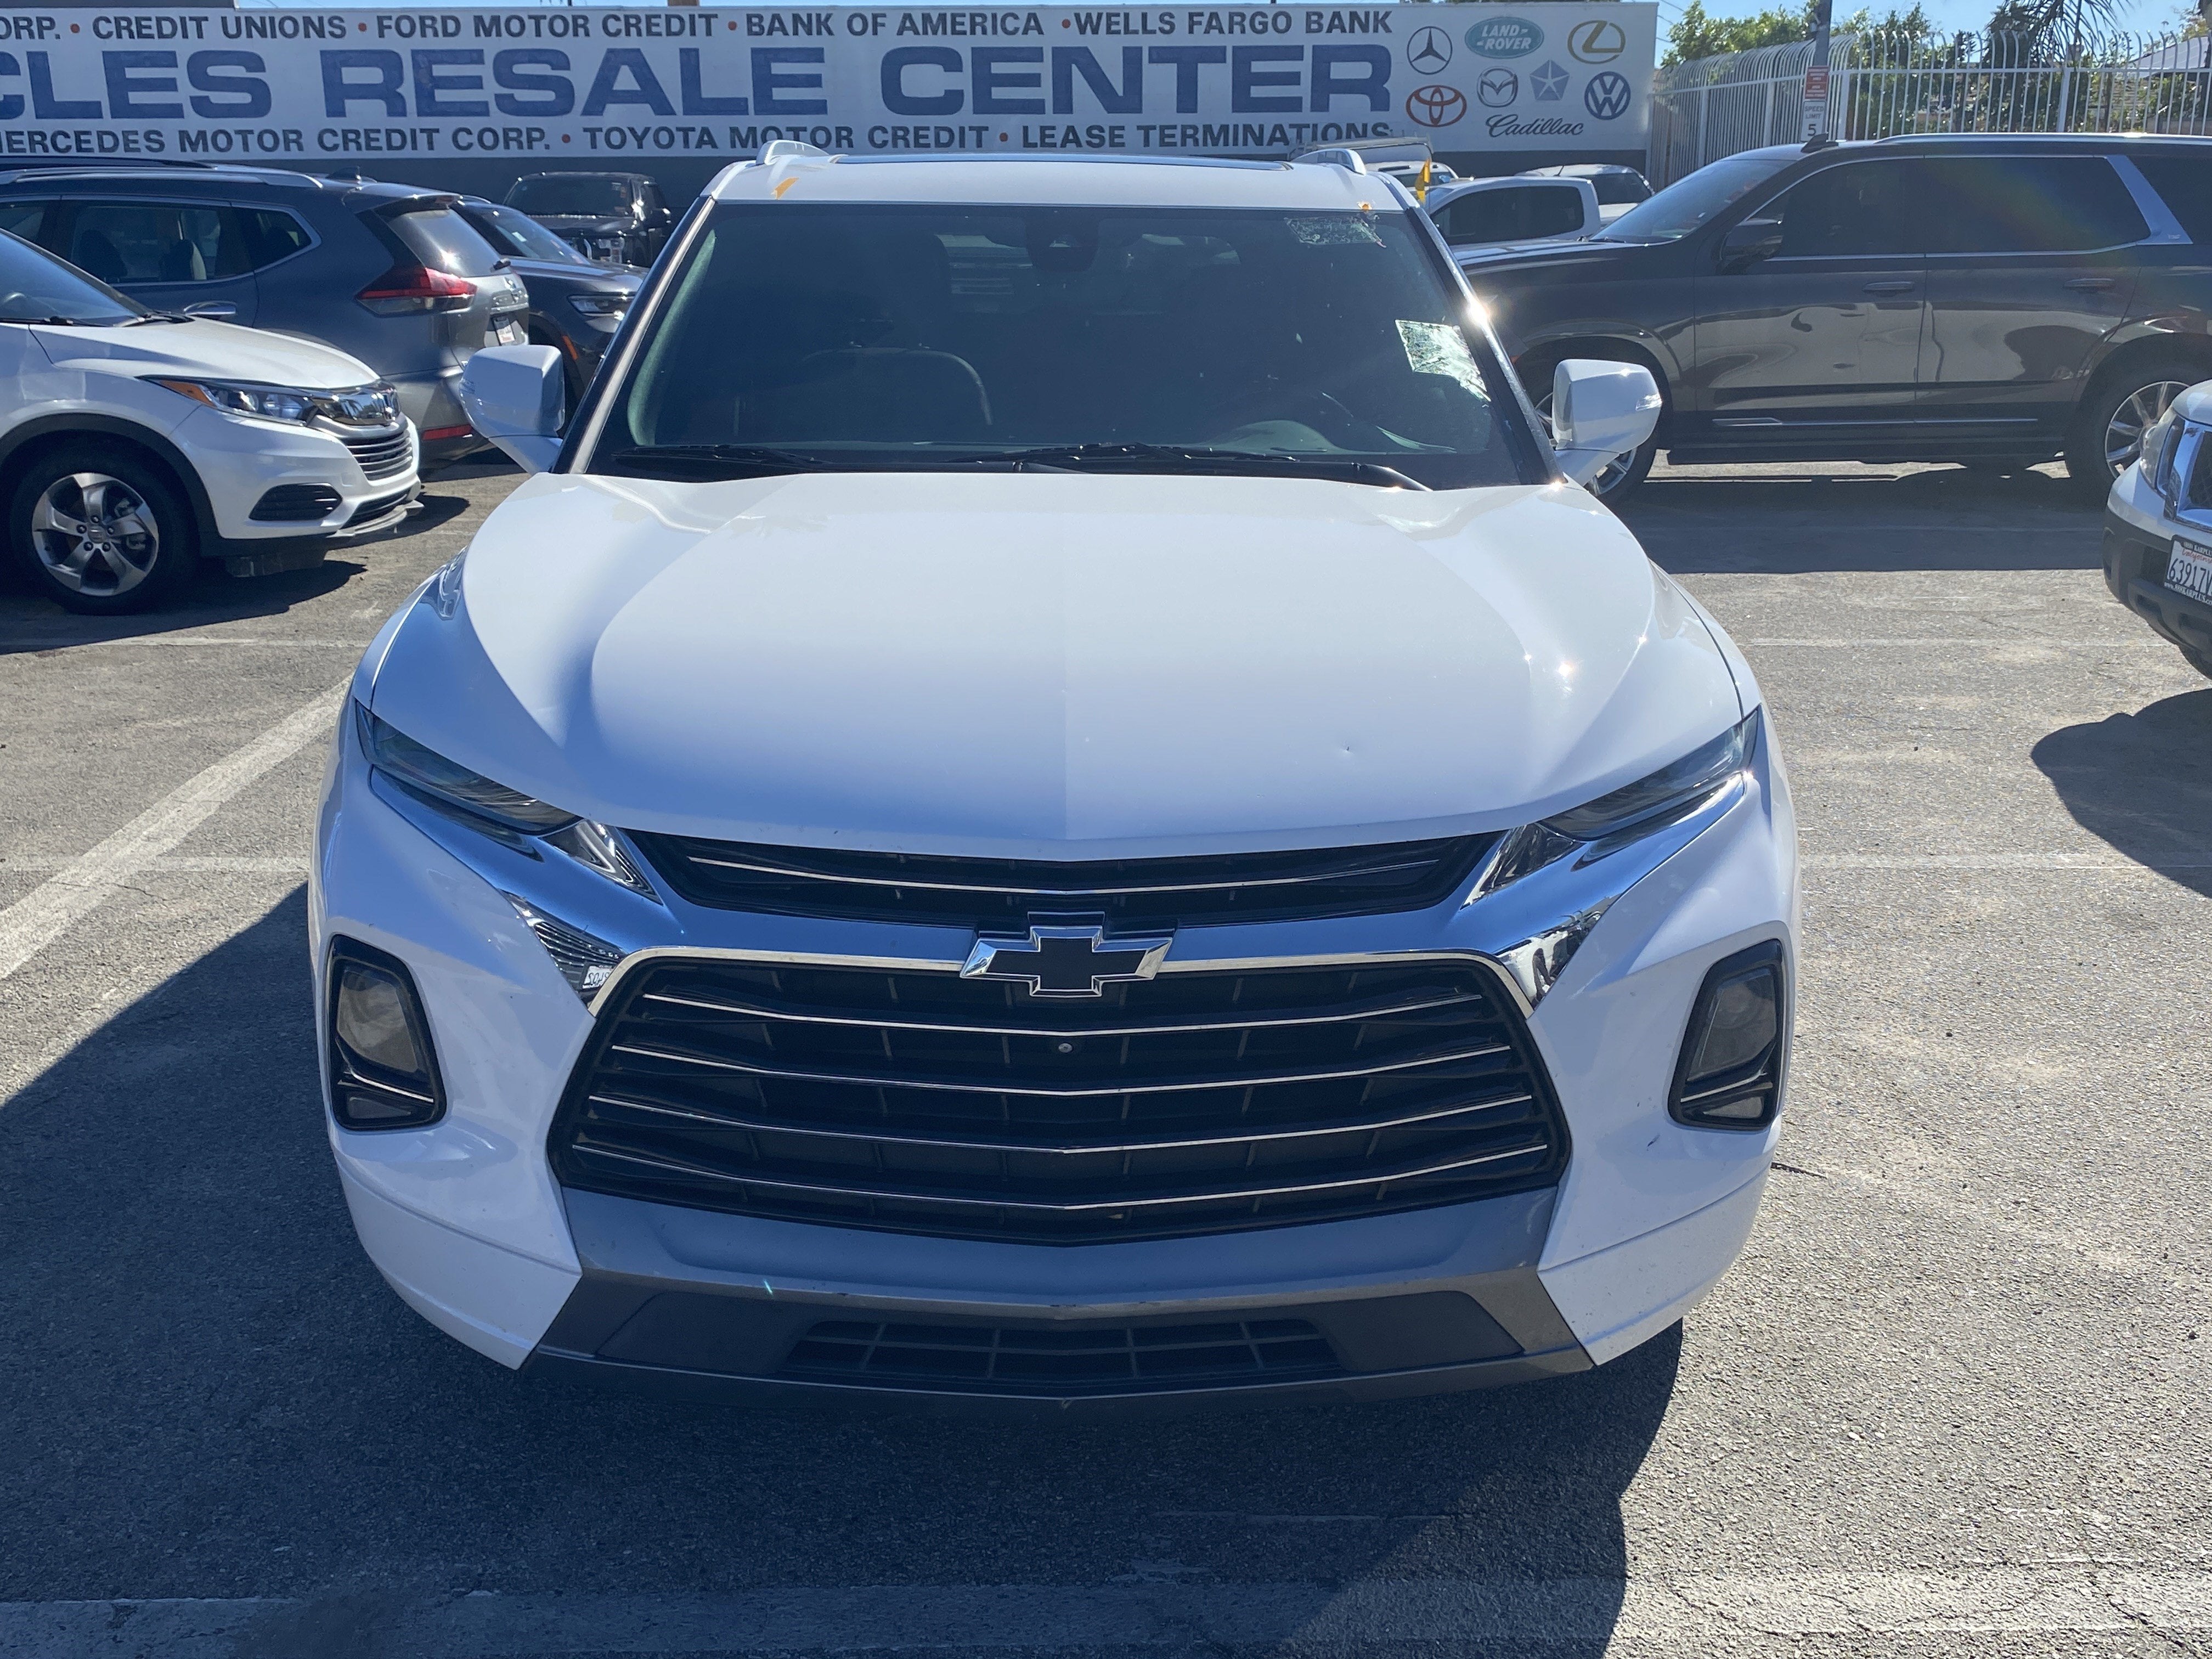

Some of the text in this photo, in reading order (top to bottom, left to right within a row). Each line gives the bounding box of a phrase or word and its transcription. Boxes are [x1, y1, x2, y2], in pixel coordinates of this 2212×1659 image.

[92, 15, 209, 40] CREDIT
[221, 15, 347, 40] UNIONS
[377, 14, 461, 38] FORD
[474, 14, 590, 38] MOTOR
[601, 13, 718, 37] CREDIT
[746, 13, 834, 37] BANK
[847, 12, 887, 36] OF
[896, 12, 1044, 36] AMERICA
[1074, 12, 1176, 35] WELLS
[1188, 10, 1292, 35] FARGO
[1305, 10, 1393, 34] BANK
[0, 44, 1392, 120] LES RESALE CENTER
[0, 122, 1390, 154] ERCEDES MOTOR CREDIT CORP. TOYOTA MOTOR CREDIT LEASE TERMINATIONS
[1486, 114, 1584, 138] Cadillac
[1807, 124, 1816, 136] 5
